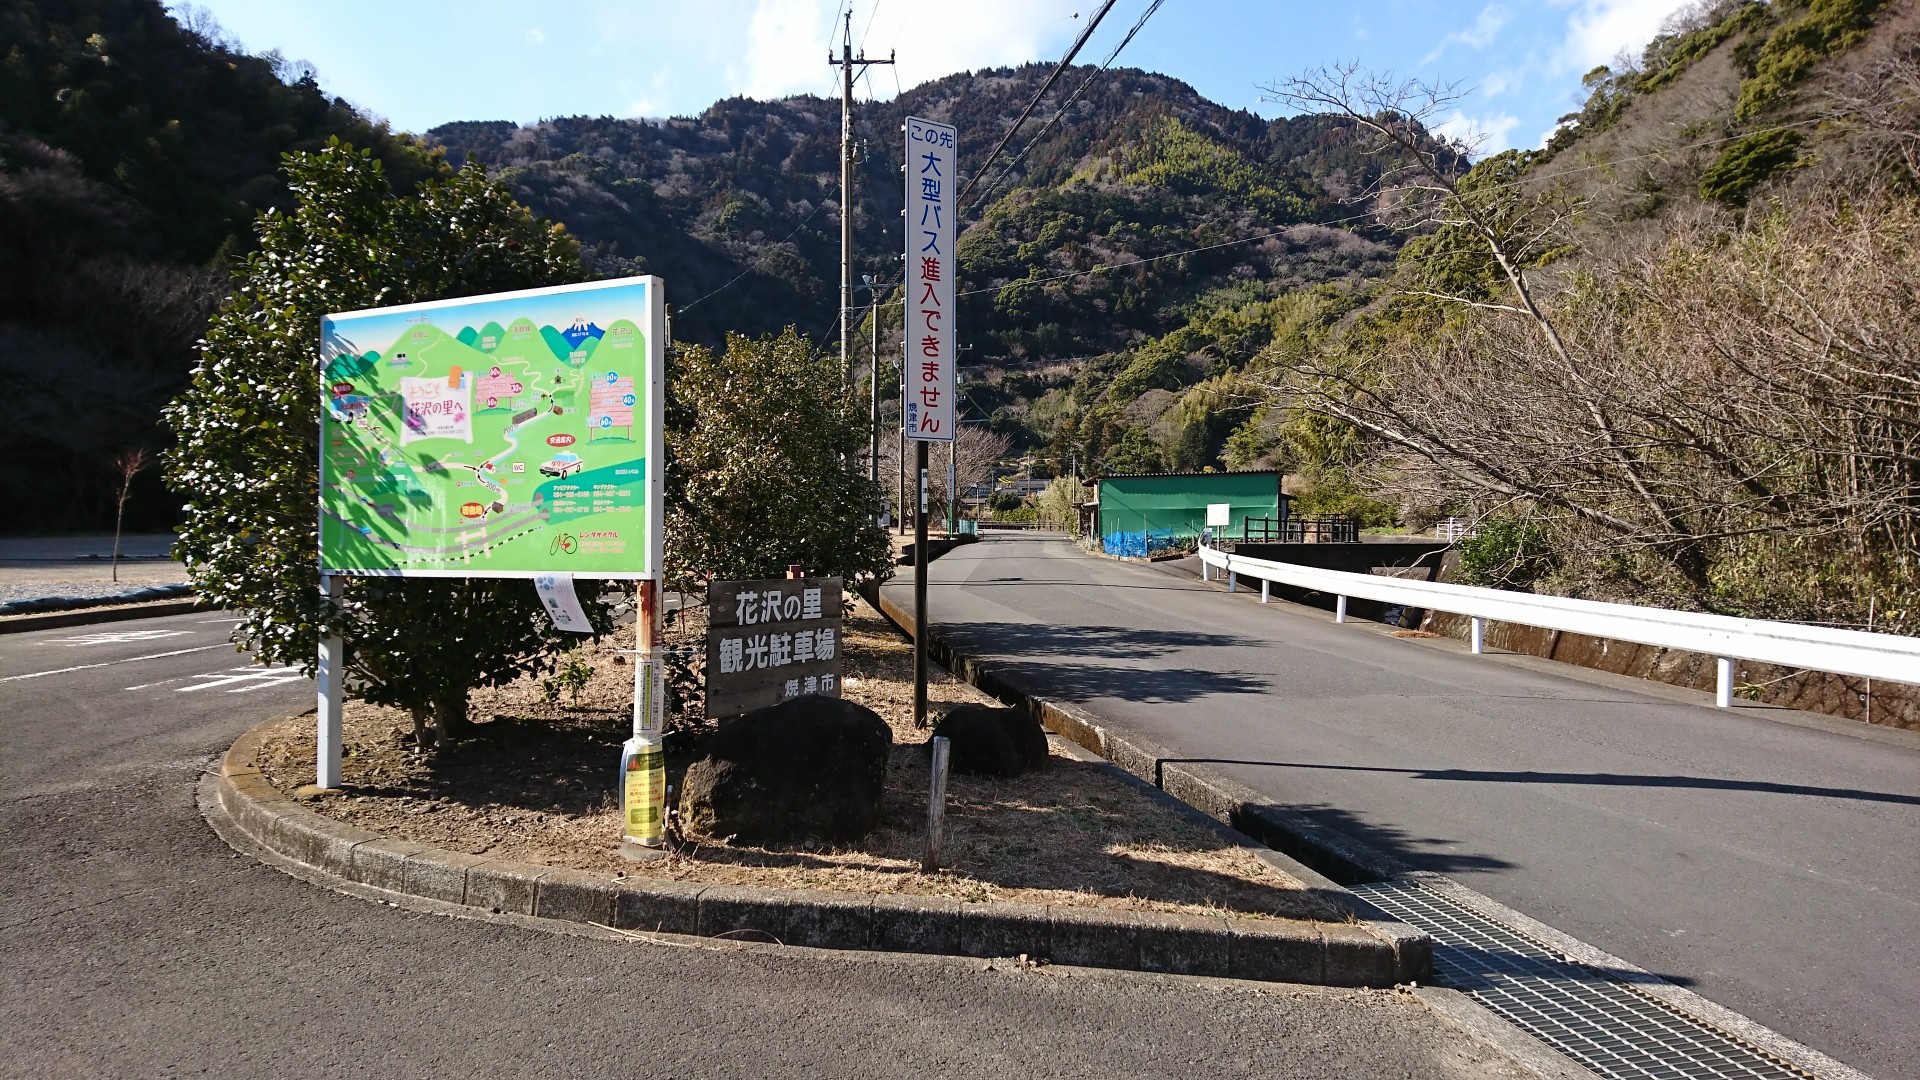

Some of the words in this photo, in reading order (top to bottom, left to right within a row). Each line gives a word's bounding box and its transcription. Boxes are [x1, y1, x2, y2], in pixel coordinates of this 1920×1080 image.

[911, 125, 953, 149] この先
[920, 151, 942, 433] 大型バス進入できません
[409, 400, 464, 418] 花沢の里へ
[908, 402, 918, 434] 焼津市
[735, 588, 823, 626] 花沢の里
[718, 628, 836, 675] 観光駐車場
[784, 673, 835, 697] 焼津市
